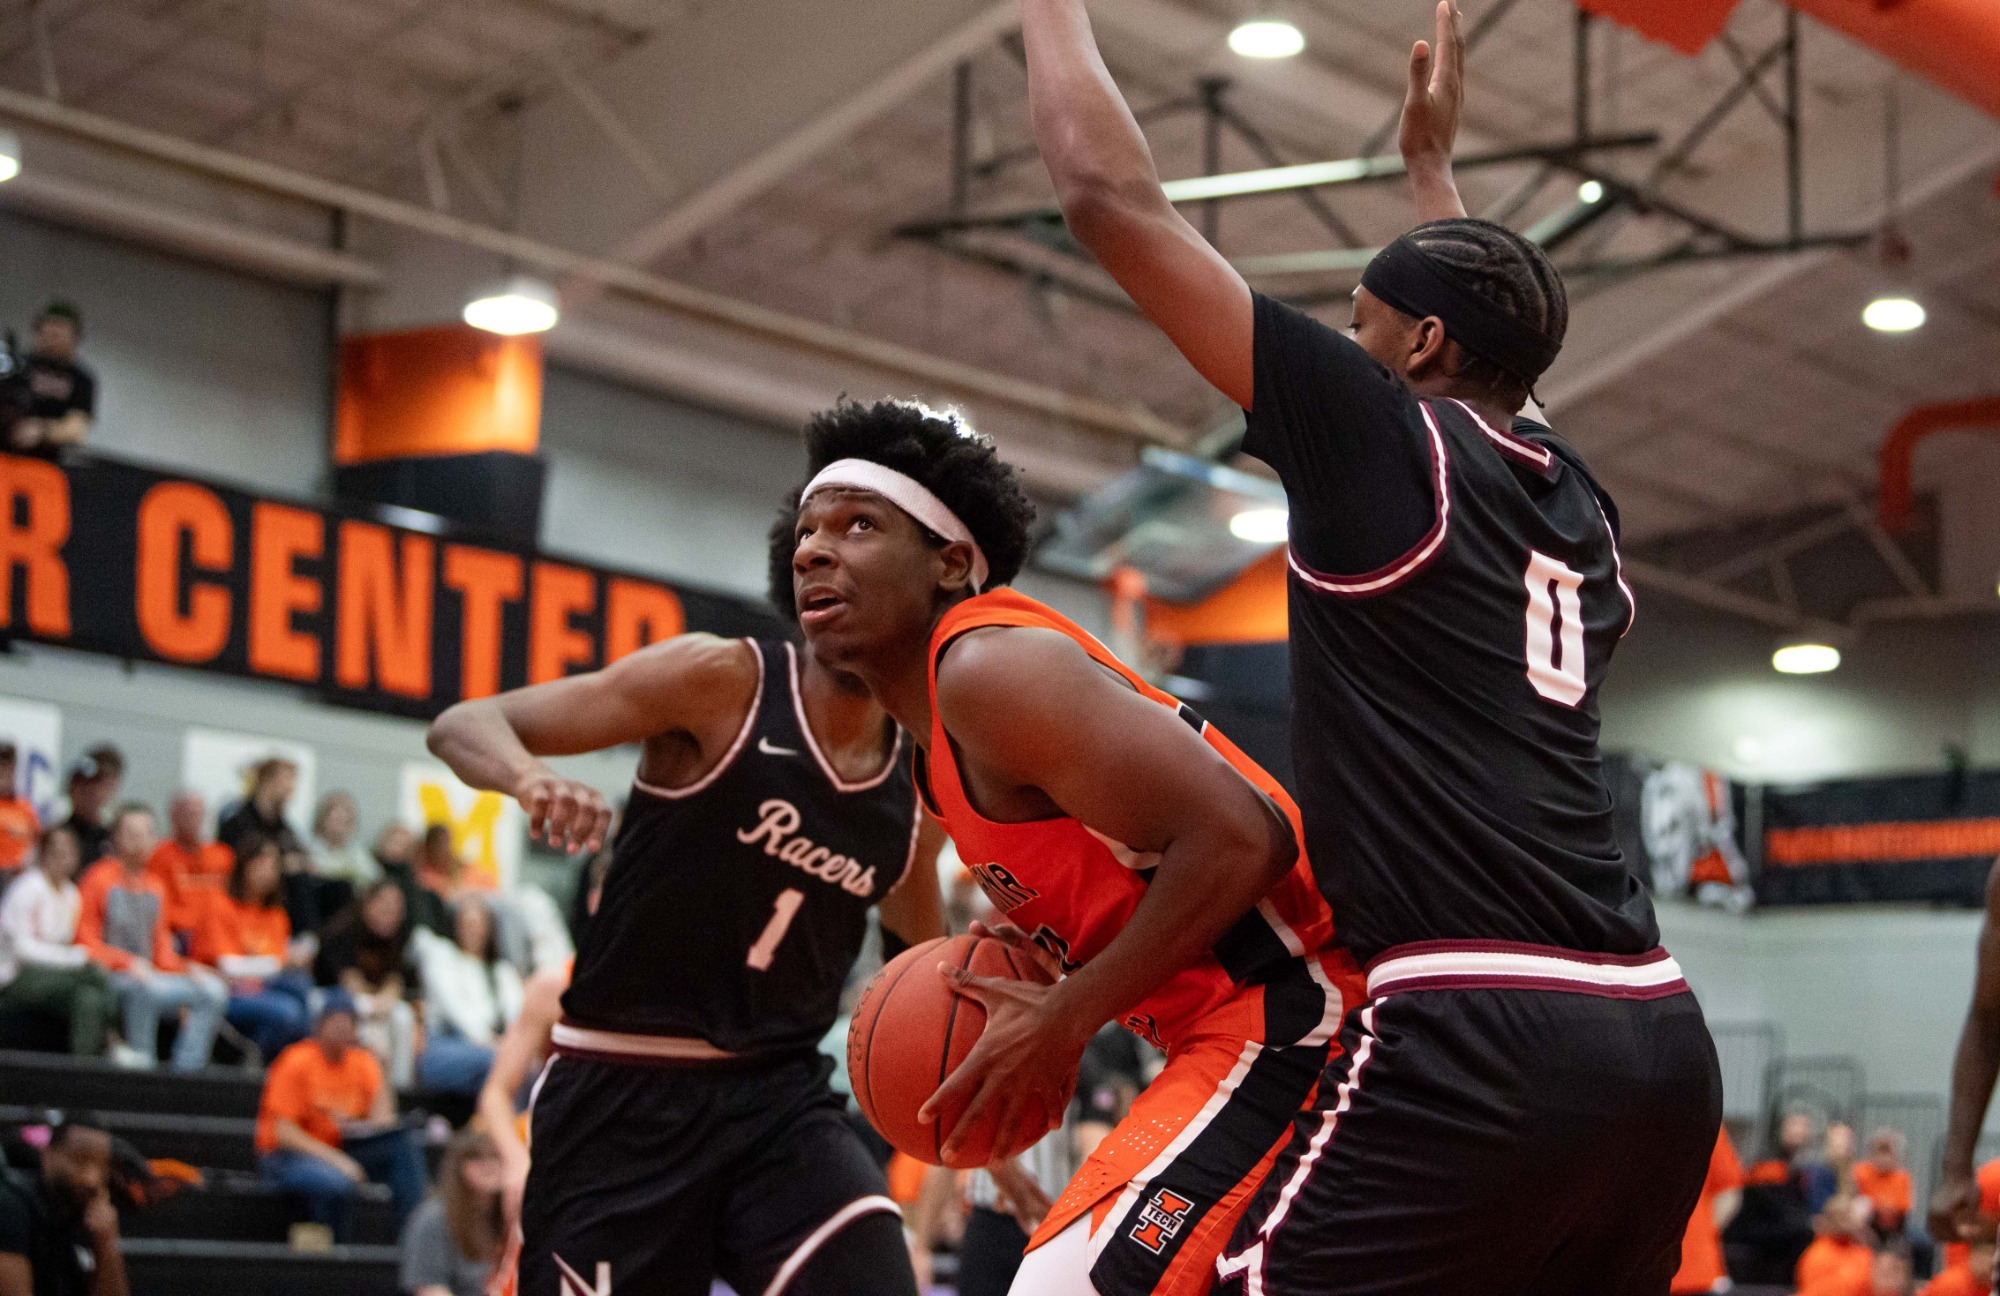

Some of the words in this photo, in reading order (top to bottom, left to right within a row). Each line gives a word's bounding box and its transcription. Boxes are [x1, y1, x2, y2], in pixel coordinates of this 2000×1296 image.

[1525, 550, 1586, 708] 0
[736, 798, 876, 898] Racers
[746, 887, 805, 971] 1
[1147, 1206, 1178, 1231] TECH
